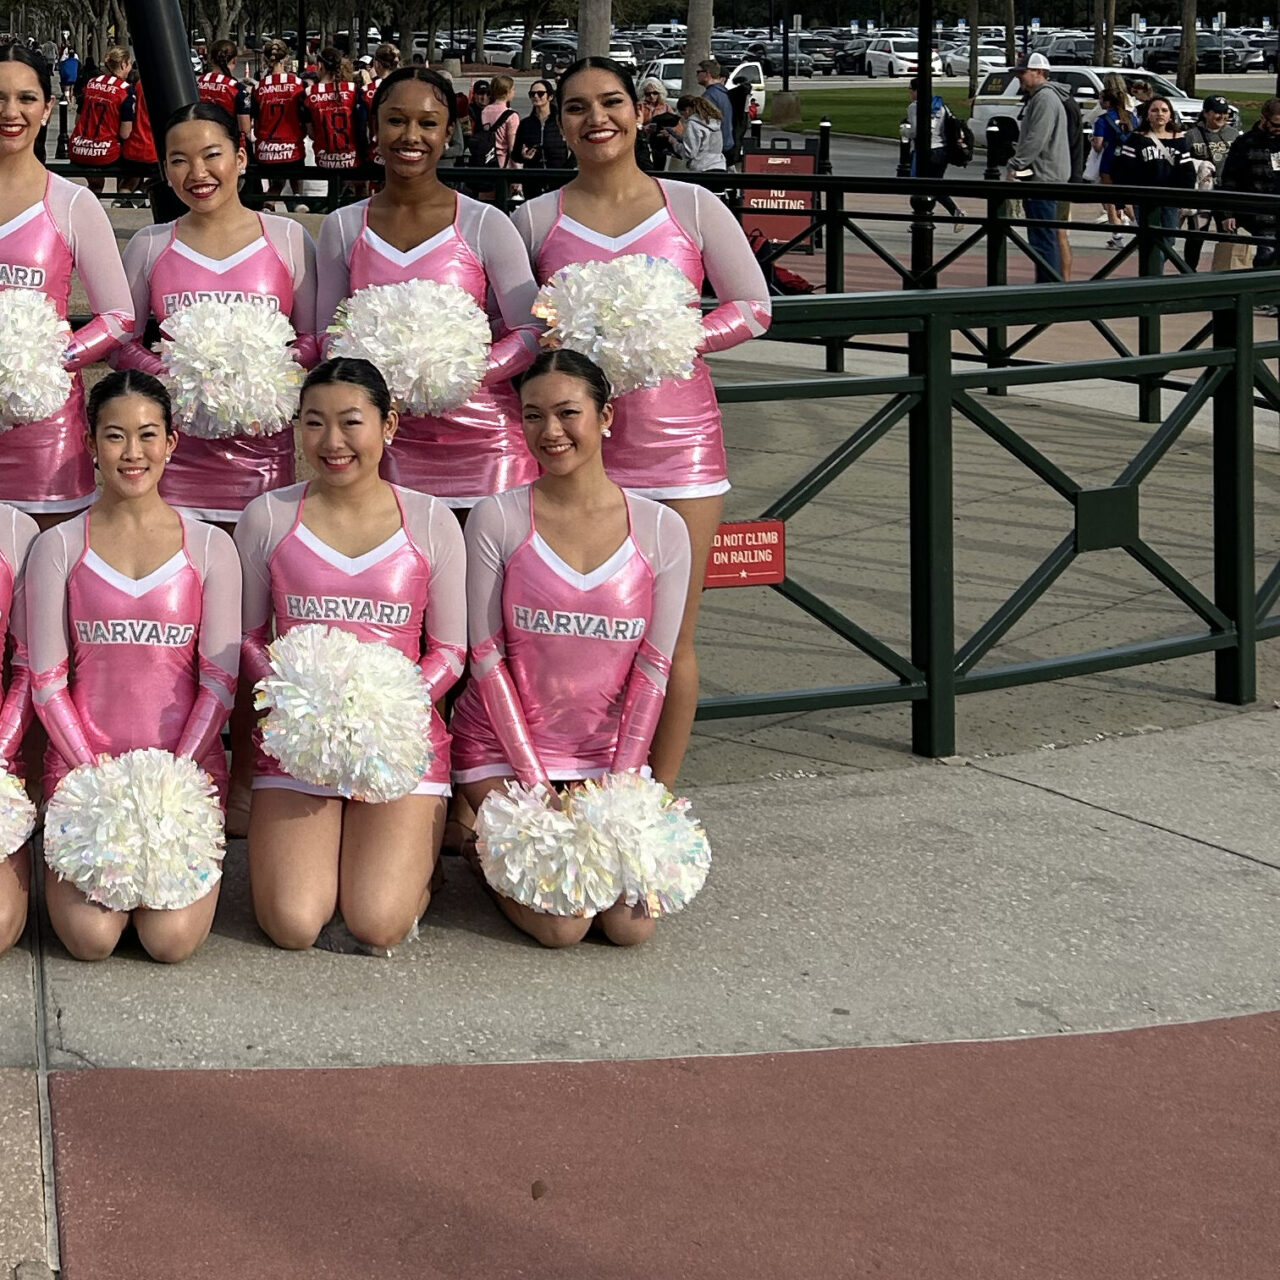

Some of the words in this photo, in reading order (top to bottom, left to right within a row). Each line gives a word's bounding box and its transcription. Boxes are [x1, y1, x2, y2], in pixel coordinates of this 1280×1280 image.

[259, 83, 295, 95] OMNILIFE
[750, 198, 805, 210] STUNTING
[723, 533, 744, 546] NOT
[745, 531, 778, 545] CLIMB
[713, 551, 728, 564] ON
[730, 549, 772, 563] RAILING
[285, 595, 412, 626] HARVARD
[512, 604, 645, 642] HARVARD
[75, 619, 195, 648] HARVARD
